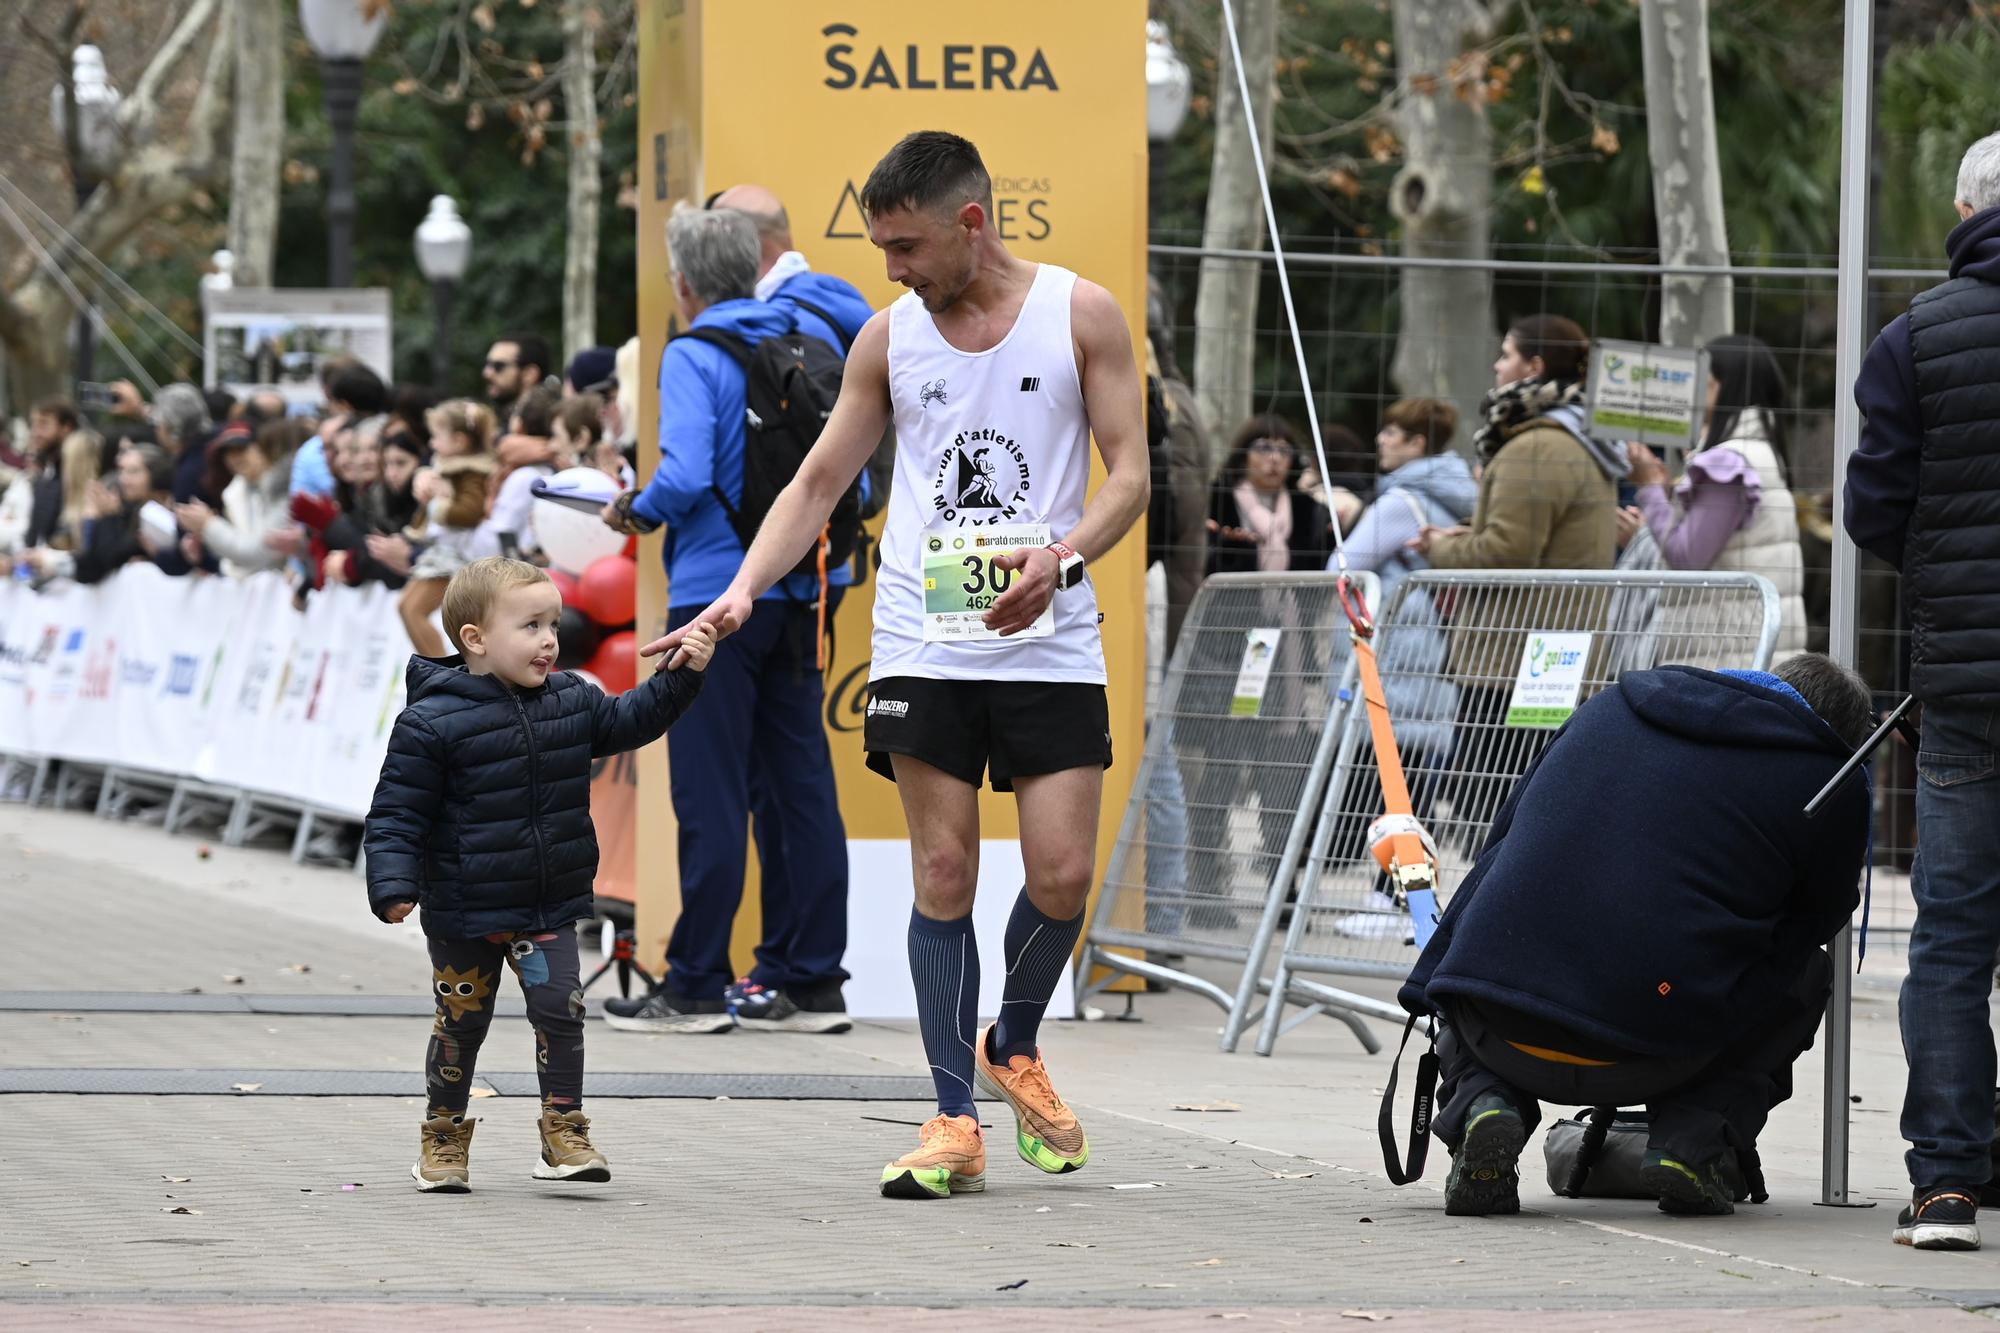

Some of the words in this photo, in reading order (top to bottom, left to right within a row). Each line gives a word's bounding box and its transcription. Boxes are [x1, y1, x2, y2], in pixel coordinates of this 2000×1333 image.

[824, 43, 1059, 91] SALERA
[992, 175, 1052, 193] ÉDICAS
[877, 700, 909, 713] DOSZERO
[1415, 1095, 1428, 1134] Canon
